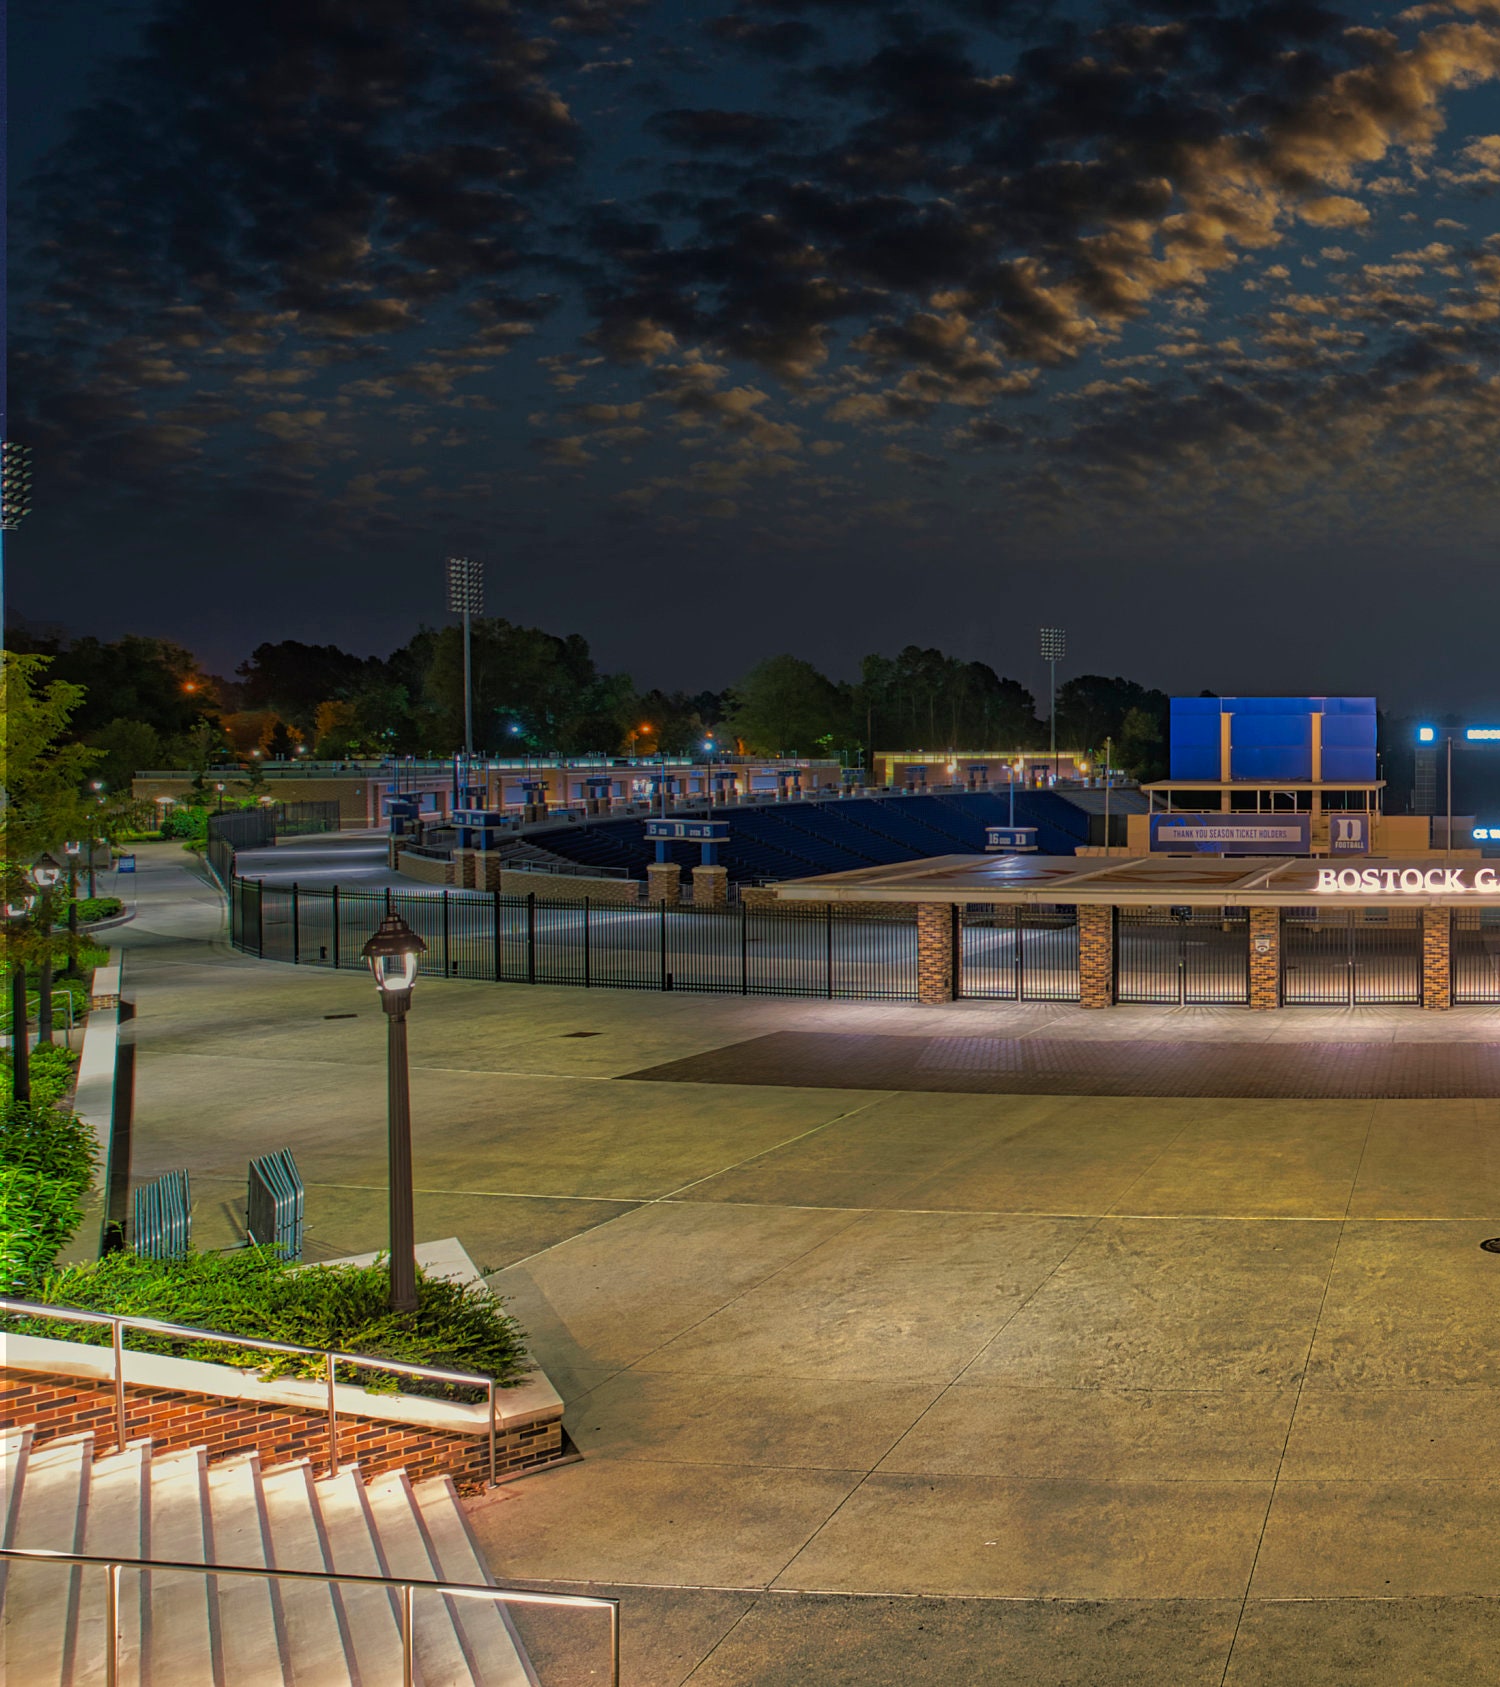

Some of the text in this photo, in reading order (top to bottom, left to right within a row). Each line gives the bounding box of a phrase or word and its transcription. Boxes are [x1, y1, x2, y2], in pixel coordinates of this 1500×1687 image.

[1173, 829, 1287, 839] THANK YOU SEASON TICKET HOLDERS
[1335, 841, 1365, 849] FOOTBALL
[1317, 868, 1466, 893] BOSTOCK
